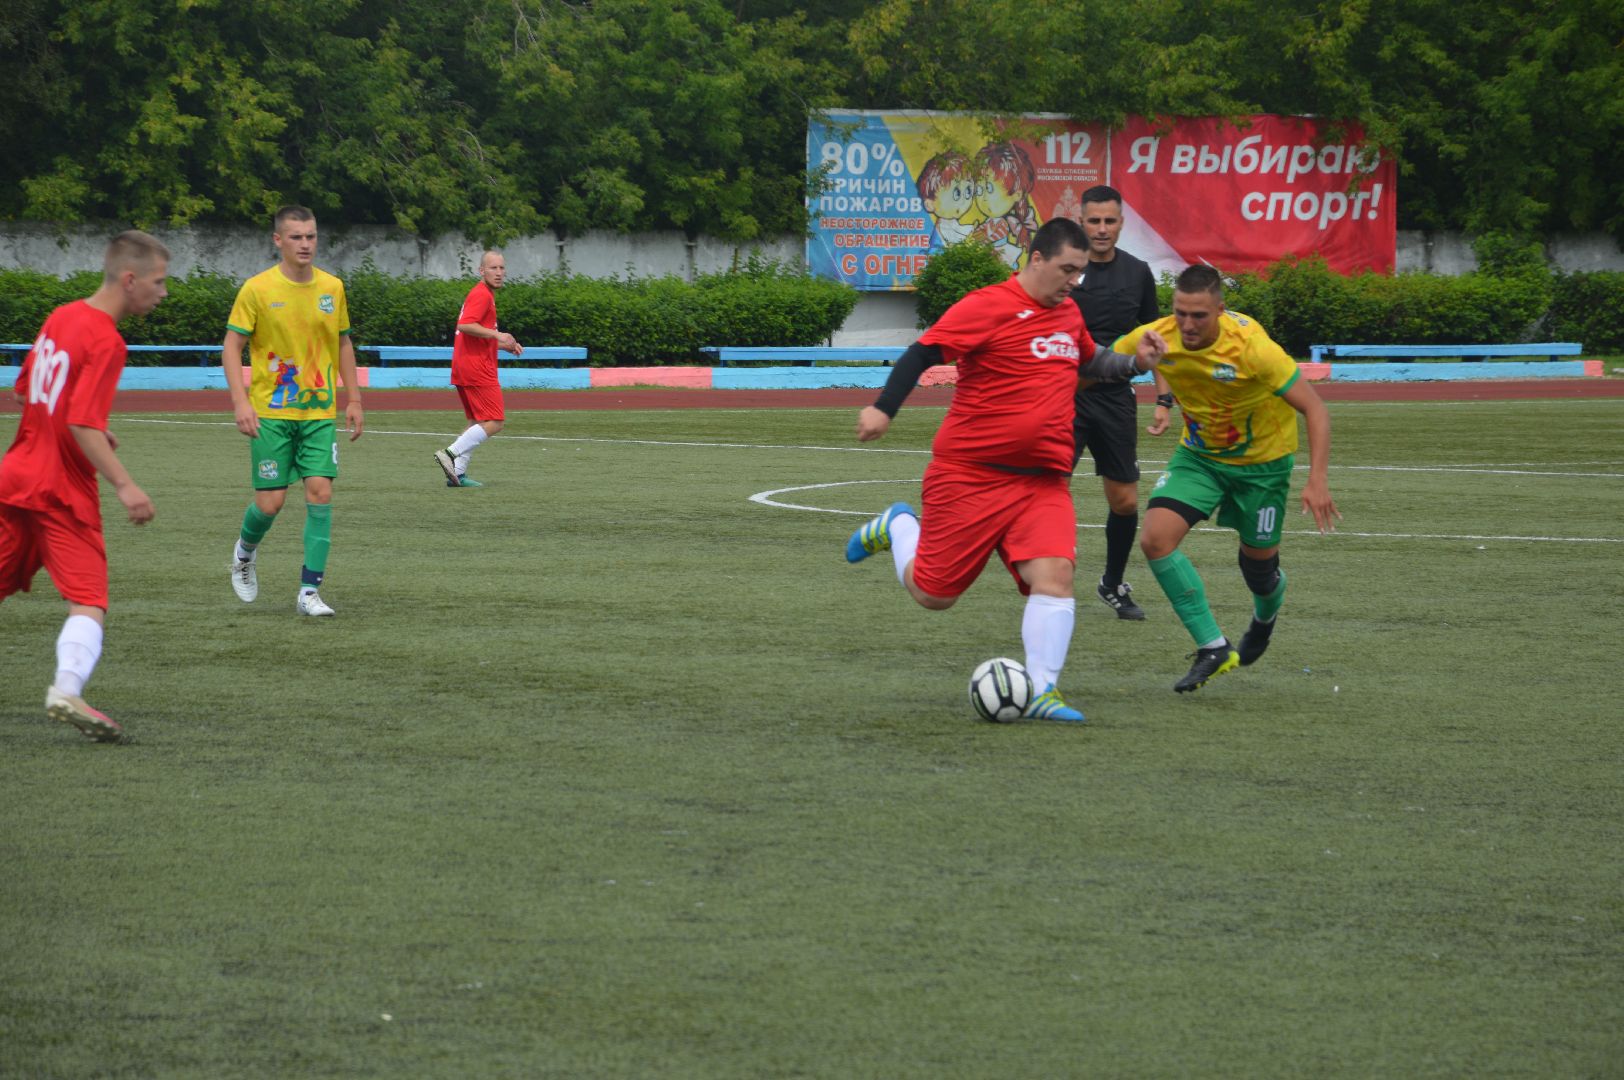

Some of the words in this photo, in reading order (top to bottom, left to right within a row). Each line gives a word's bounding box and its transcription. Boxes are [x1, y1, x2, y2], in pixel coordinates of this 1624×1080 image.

[820, 142, 905, 177] 80%
[1045, 131, 1091, 164] 112
[1127, 136, 1160, 174] Я
[820, 196, 922, 212] ПОЖАРОВ
[1240, 183, 1383, 230] спорт!
[819, 217, 925, 230] НЕОСТОРОЖНОЕ
[834, 233, 930, 249] ОБРАЩЕНИЕ
[841, 253, 858, 276] С
[864, 253, 933, 276] ОГНЕ
[1256, 505, 1277, 533] 10
